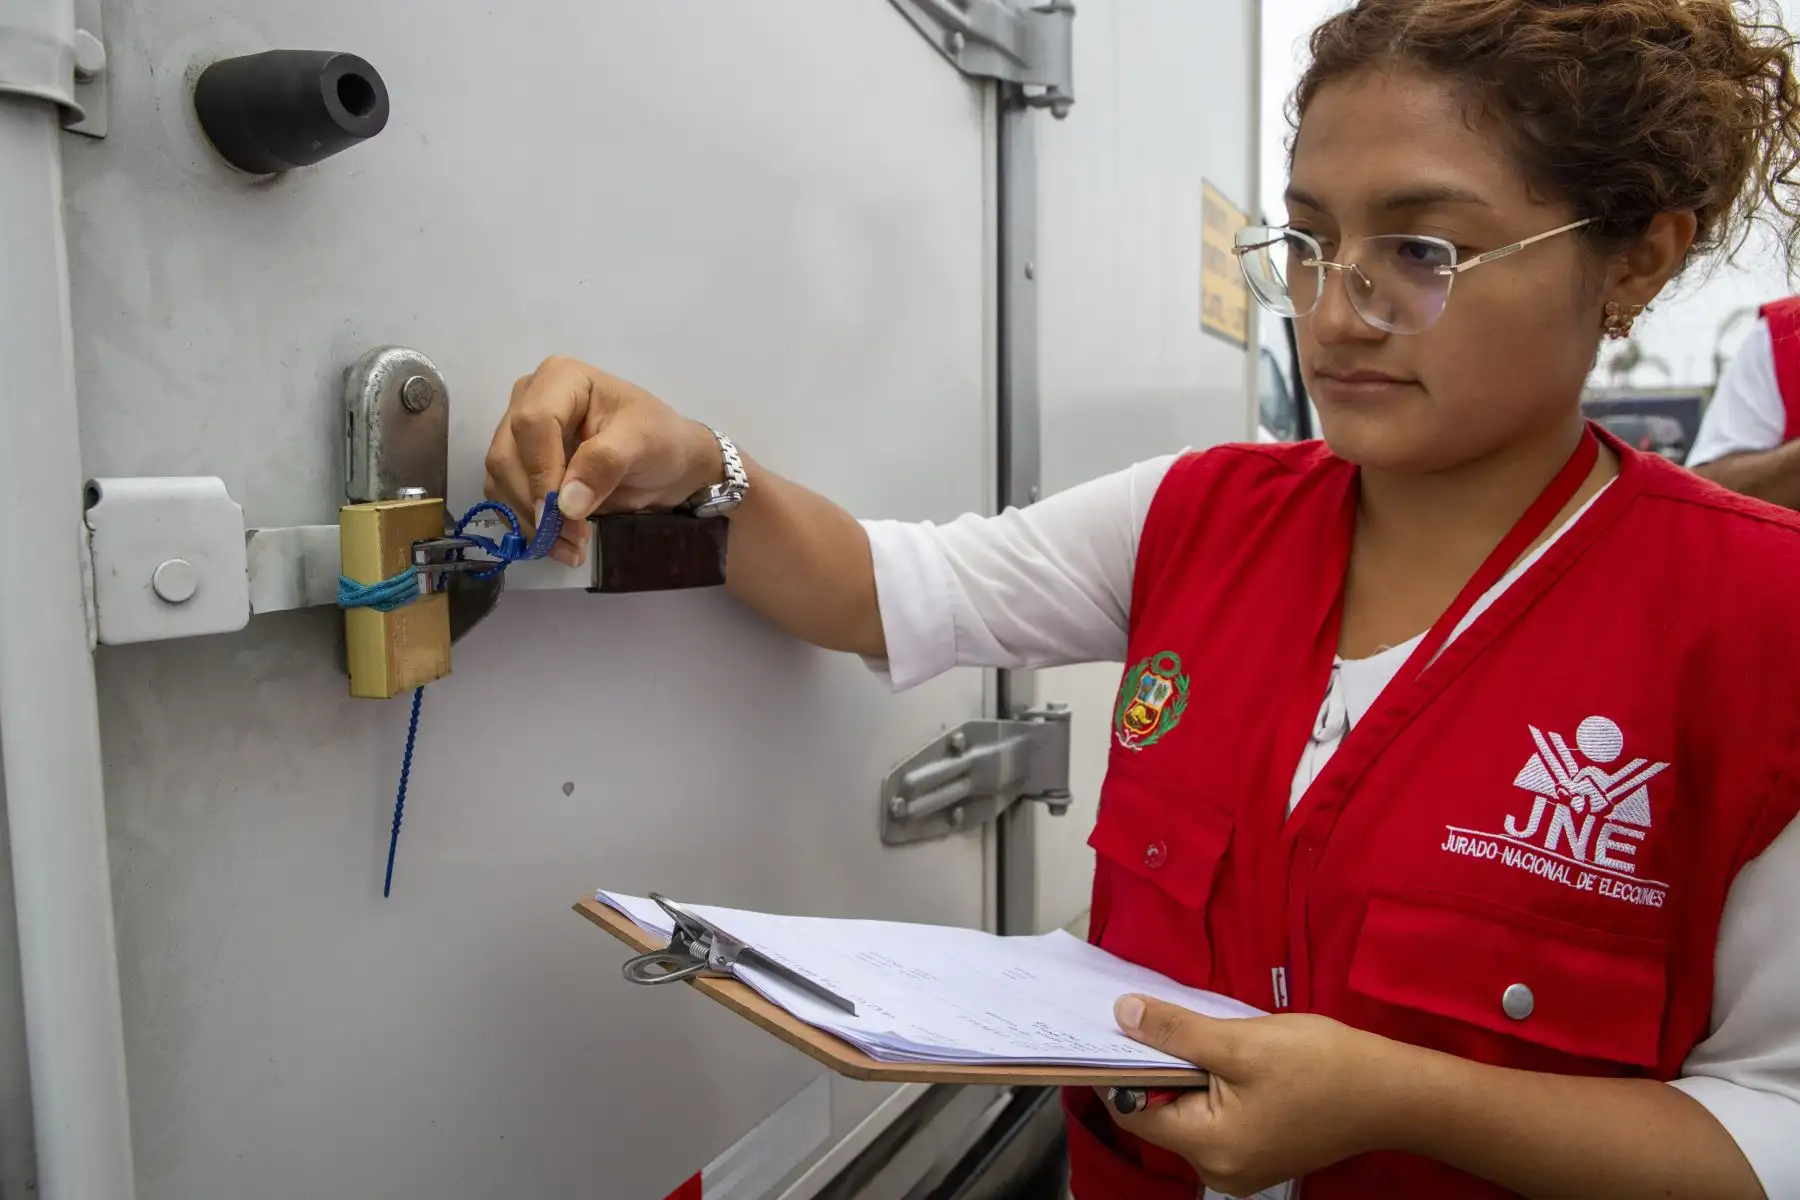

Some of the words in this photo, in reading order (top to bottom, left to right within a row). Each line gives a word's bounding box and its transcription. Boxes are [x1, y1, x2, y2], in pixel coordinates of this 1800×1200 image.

[1441, 834, 1498, 860] JURADO
[1501, 845, 1571, 885] NACIONAL
[1577, 871, 1596, 891] DE
[1504, 795, 1646, 873] JNE
